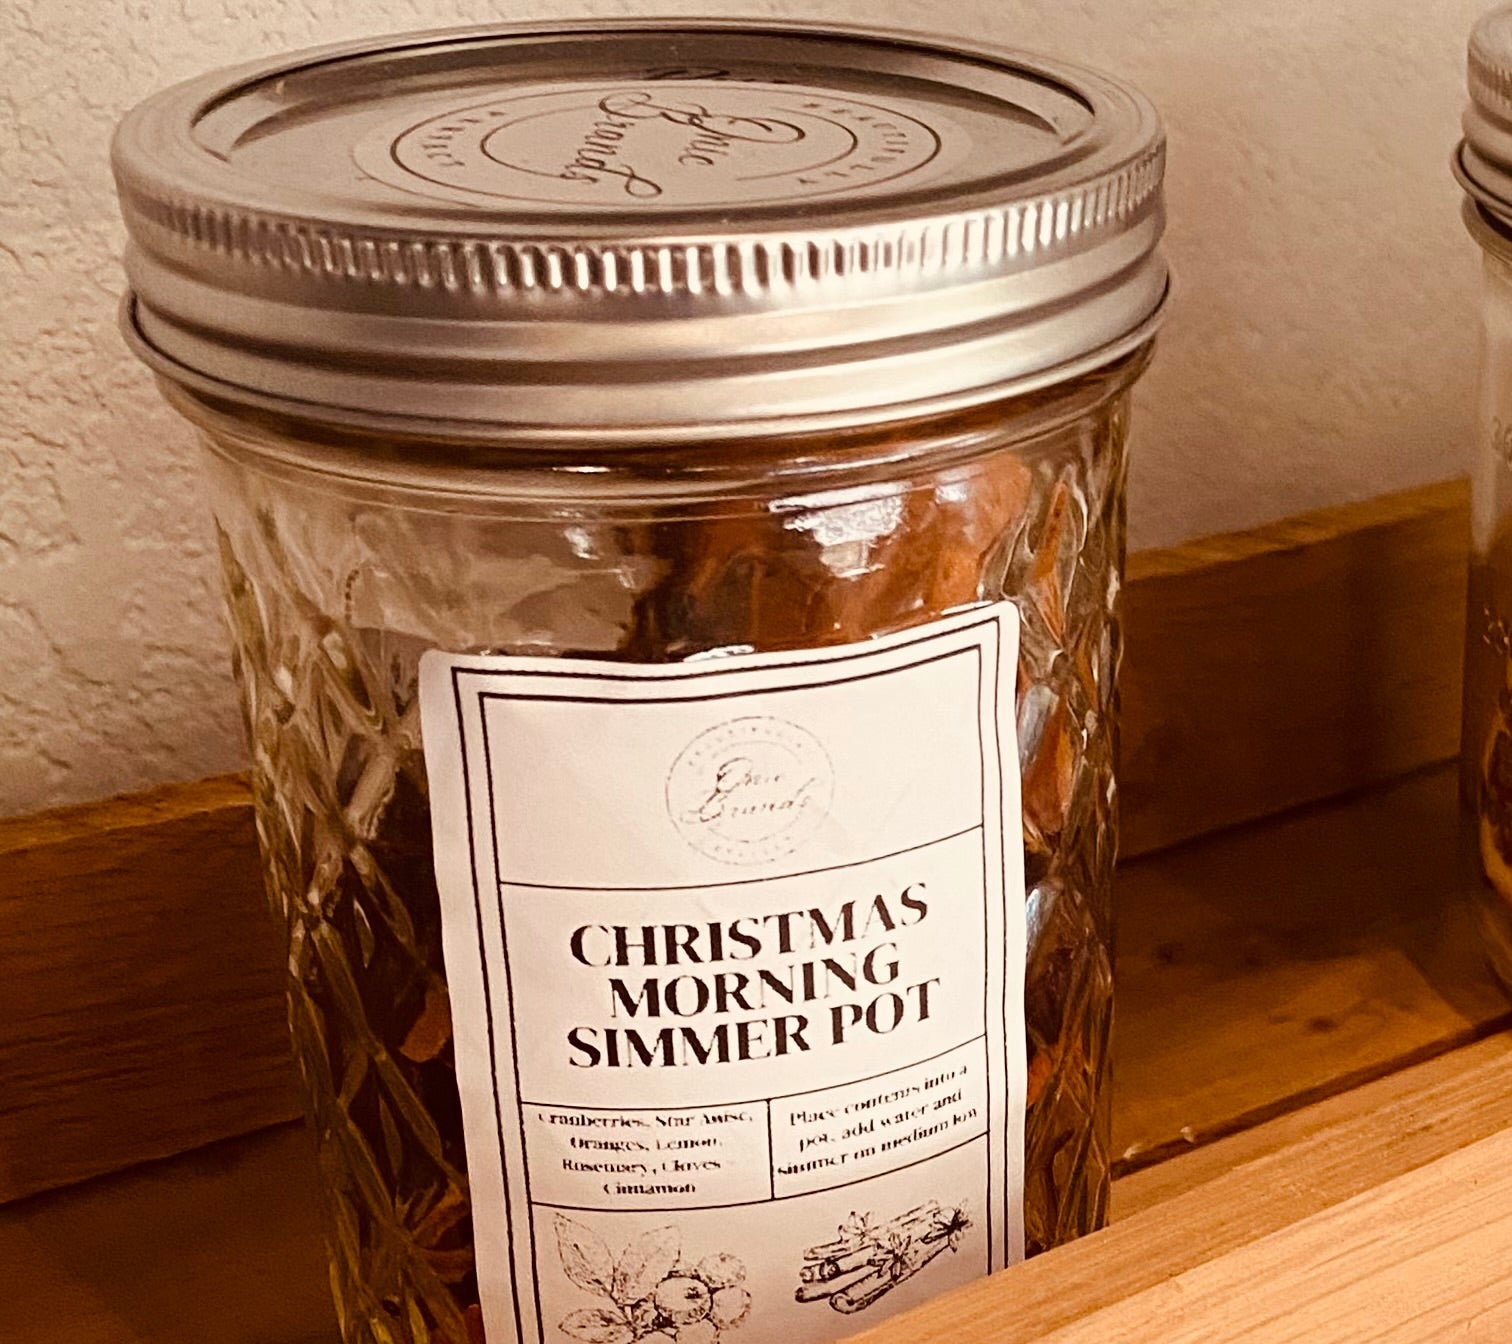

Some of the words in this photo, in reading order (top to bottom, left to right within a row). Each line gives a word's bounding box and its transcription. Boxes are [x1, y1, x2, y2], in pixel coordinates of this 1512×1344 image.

[569, 882, 929, 967] CHRISTMAS
[608, 941, 900, 1018] MORNING
[566, 1014, 811, 1069] SIMMER
[828, 977, 941, 1046] POT
[655, 1115, 696, 1128] Star
[790, 1107, 840, 1126] Place
[844, 1085, 920, 1115] contents
[924, 1071, 955, 1090] into
[958, 1065, 968, 1076] a
[841, 1119, 875, 1141] add
[880, 1104, 928, 1128] water
[933, 1087, 963, 1112] and
[570, 1136, 650, 1153] Oranges,
[661, 1159, 722, 1173] Cloves
[777, 1153, 849, 1176] simmer
[853, 1146, 876, 1161] on
[881, 1121, 949, 1152] medium
[603, 1181, 696, 1196] Cinnamon
